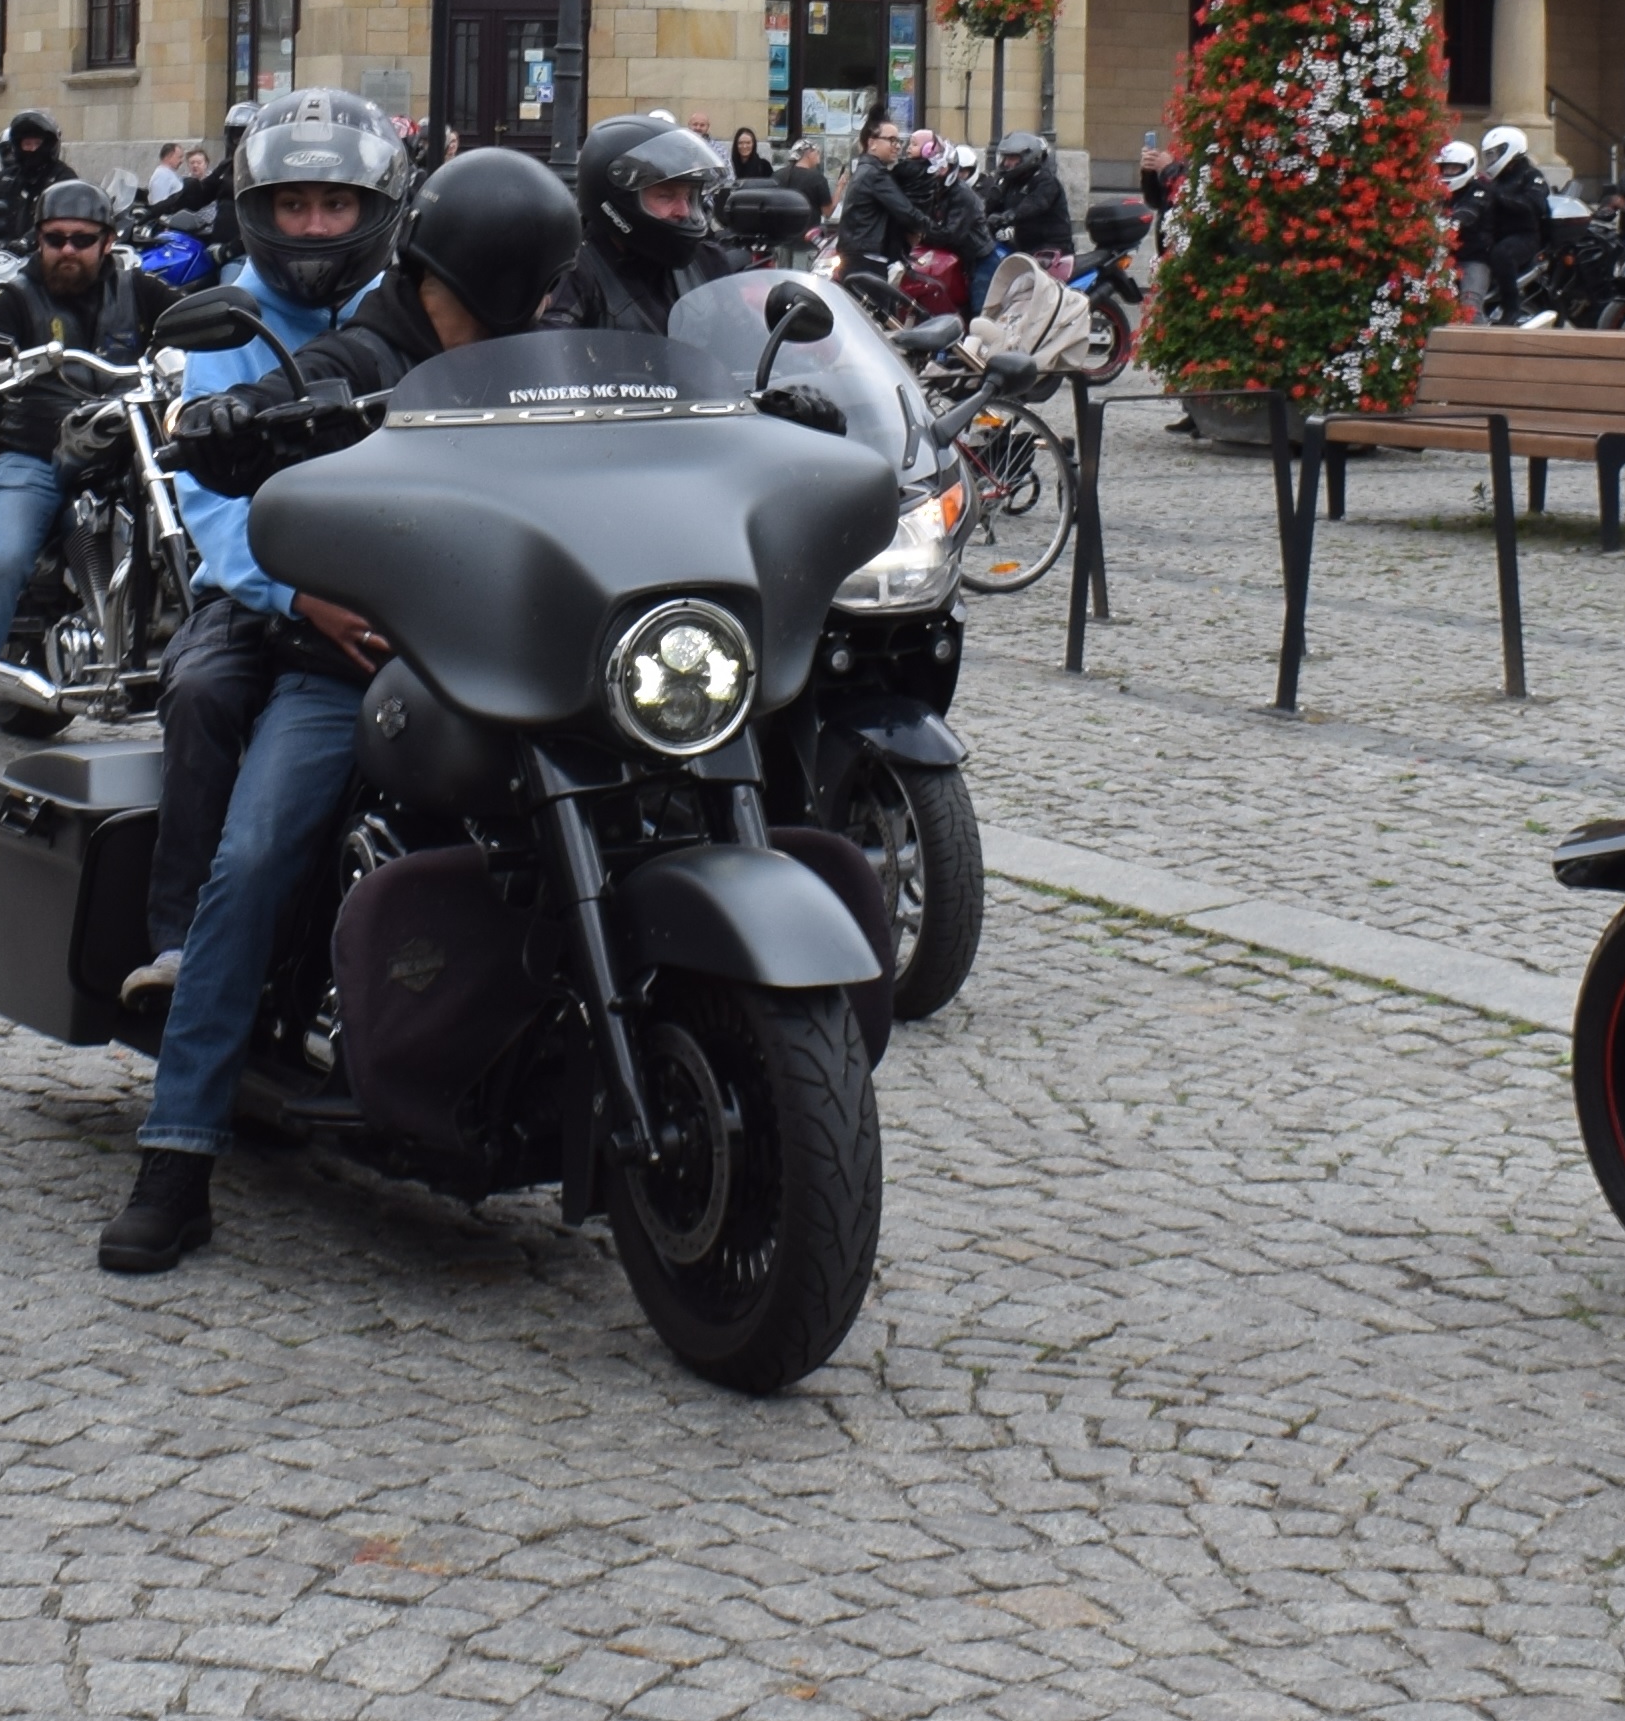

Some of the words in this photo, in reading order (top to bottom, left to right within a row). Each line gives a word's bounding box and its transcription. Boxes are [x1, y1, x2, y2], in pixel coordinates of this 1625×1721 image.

[509, 385, 591, 404] INVADERS
[593, 384, 619, 398] MC
[619, 384, 678, 399] POLAND
